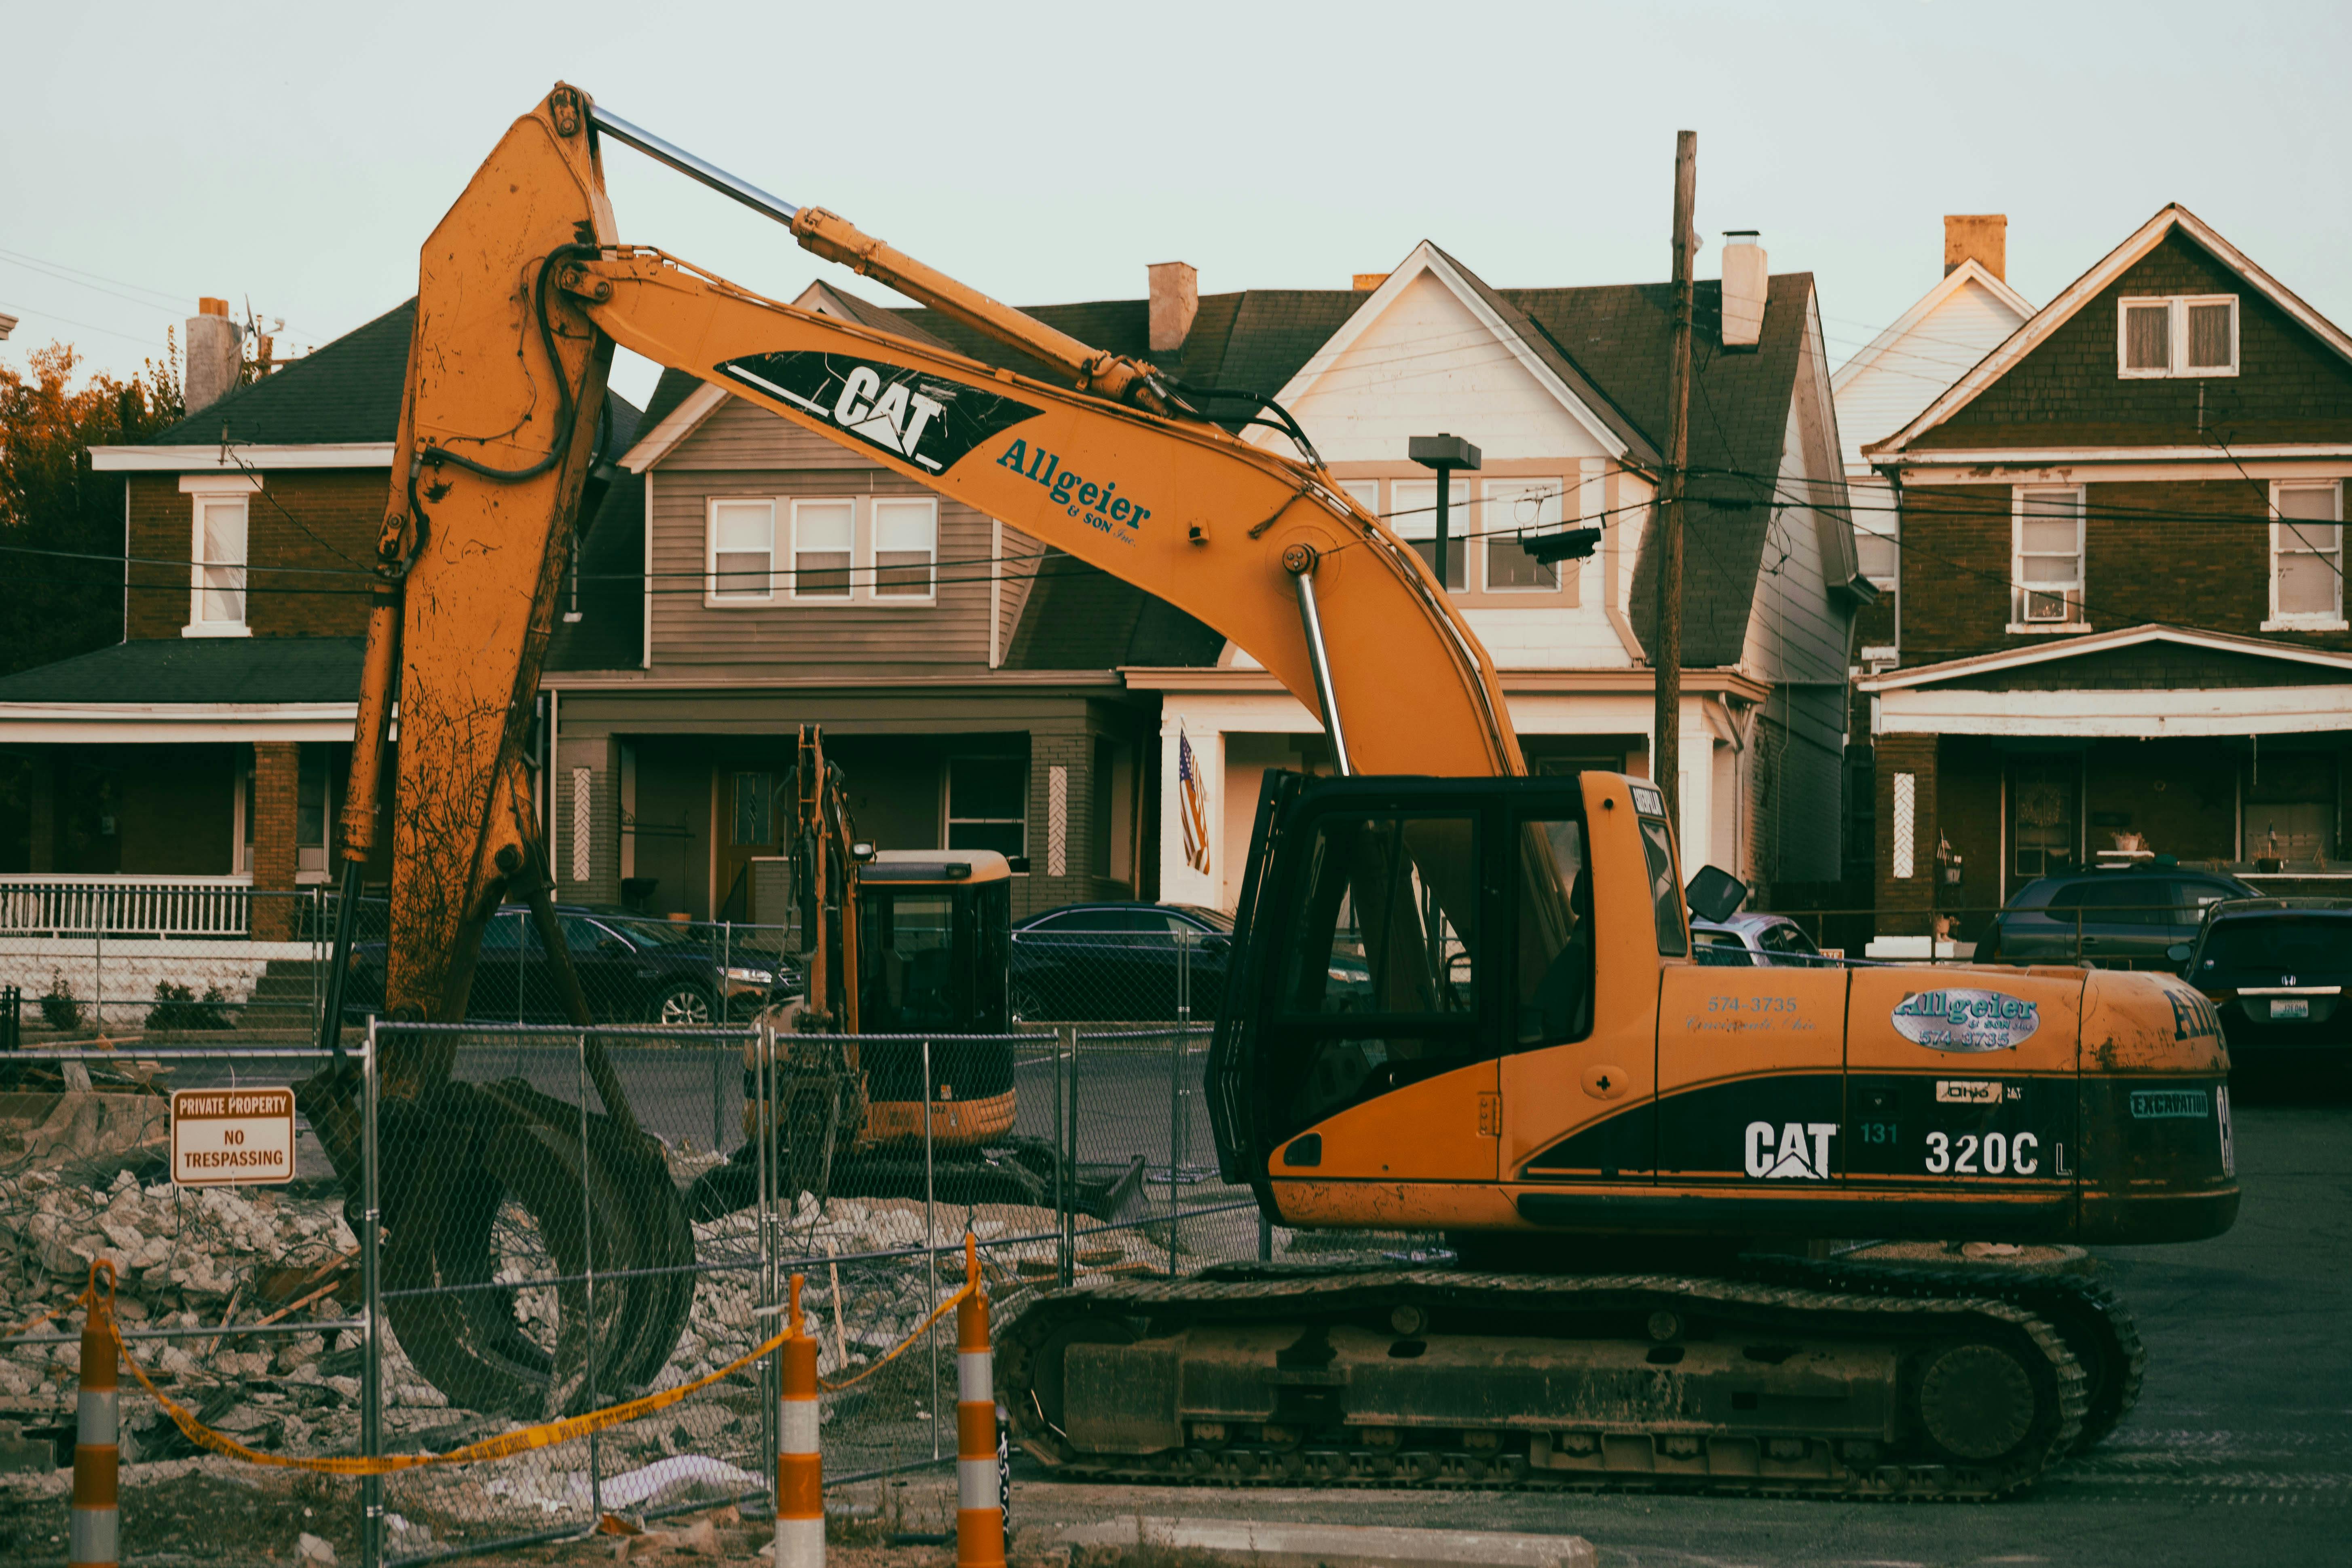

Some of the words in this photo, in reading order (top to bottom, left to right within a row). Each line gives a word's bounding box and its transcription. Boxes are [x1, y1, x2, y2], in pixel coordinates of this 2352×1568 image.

[834, 366, 941, 457] CAT
[996, 438, 1151, 530] Allgeier
[1067, 505, 1080, 517] &
[1083, 512, 1113, 533] SON
[1707, 997, 1798, 1012] 574-3735
[1894, 991, 2037, 1025] Allgeier
[1984, 1020, 2010, 1030] SON
[1919, 1030, 2009, 1047] 574-3735
[180, 1097, 225, 1116] PRIVATE
[228, 1096, 287, 1114] PROPERTY
[2133, 1094, 2208, 1114] EXCAVATION
[224, 1130, 244, 1145] NO
[1861, 1123, 1898, 1144] 131
[184, 1150, 283, 1168] TRESPASSING
[1745, 1121, 1836, 1179] CAT
[1925, 1132, 2038, 1175] 320C
